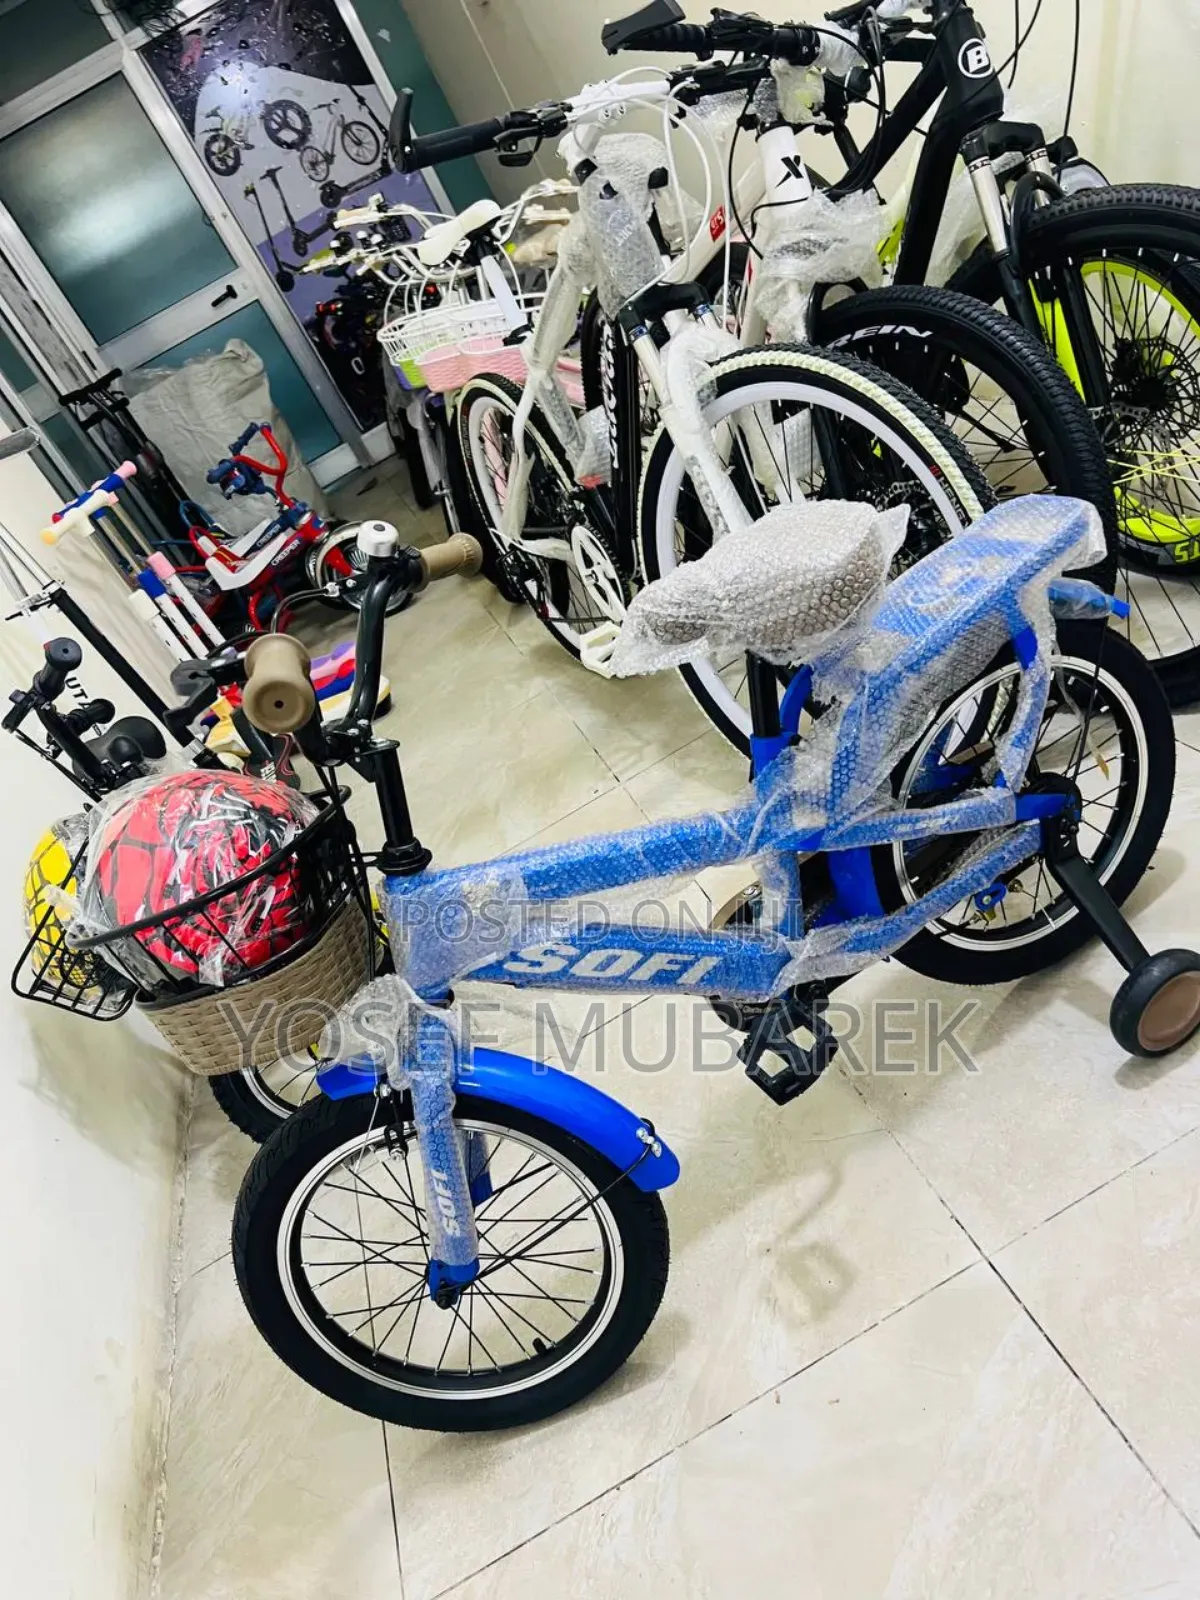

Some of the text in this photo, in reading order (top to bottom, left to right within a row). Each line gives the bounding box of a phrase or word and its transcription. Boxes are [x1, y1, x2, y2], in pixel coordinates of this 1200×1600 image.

[271, 539, 300, 566] CREEPER
[503, 941, 723, 984] SOFI
[429, 1168, 461, 1237] SOFI
